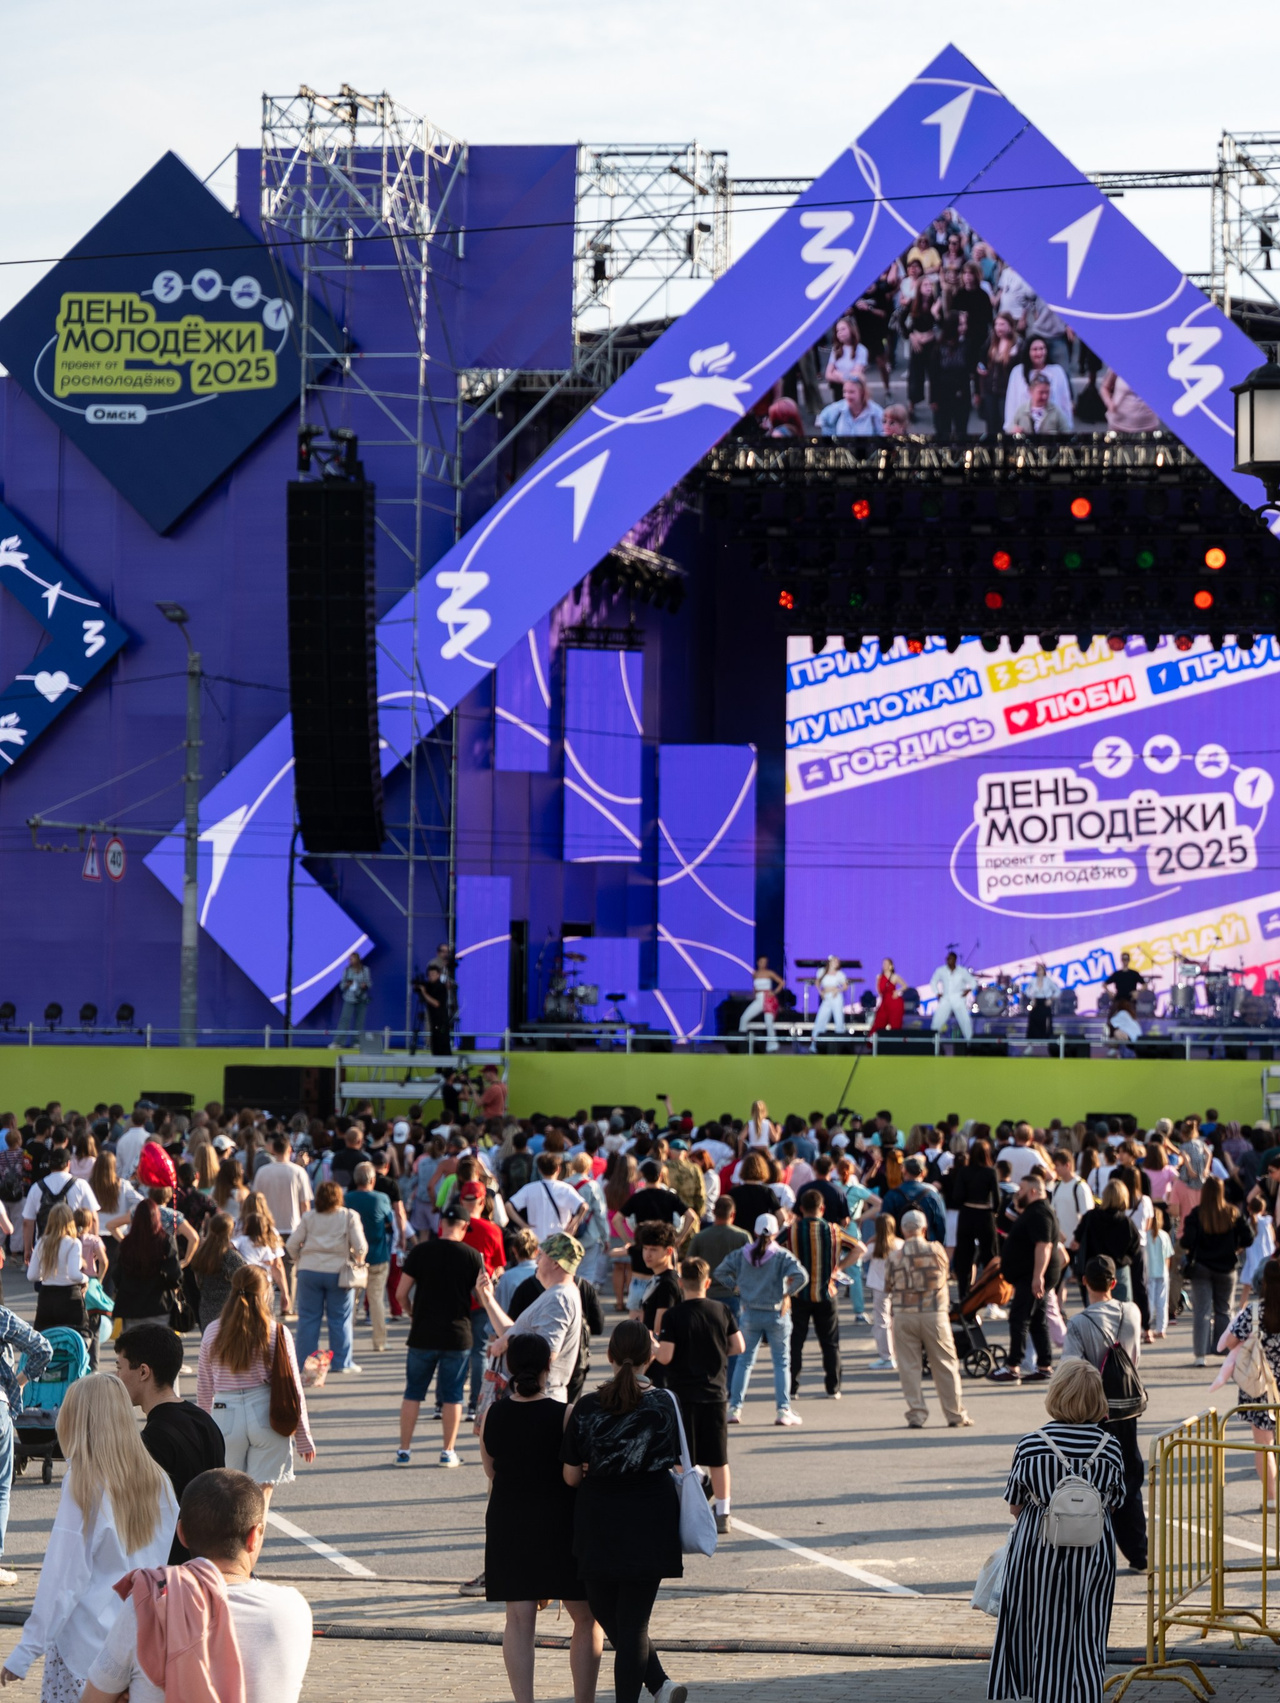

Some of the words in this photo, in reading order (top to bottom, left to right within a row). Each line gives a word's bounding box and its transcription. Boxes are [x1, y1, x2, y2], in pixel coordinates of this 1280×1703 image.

[63, 299, 149, 326] ДЕНЬ
[62, 322, 256, 358] МОЛОДЁЖИ
[60, 360, 101, 371] проект
[104, 360, 118, 369] от
[197, 357, 271, 386] 2025
[60, 372, 175, 391] росмолодёжь
[93, 408, 137, 419] Омск
[1035, 675, 1135, 725] ЛЮБИ
[828, 719, 994, 782] ГОРДИСЬ
[984, 777, 1088, 816] ДЕНЬ
[985, 799, 1227, 847] МОЛОДЁЖИ
[110, 851, 122, 868] 40
[985, 853, 1034, 869] проект
[1039, 852, 1056, 865] от
[1154, 835, 1248, 876] 2025
[986, 864, 1129, 894] росмолодёжь
[1150, 912, 1250, 966] ЗНАЙ
